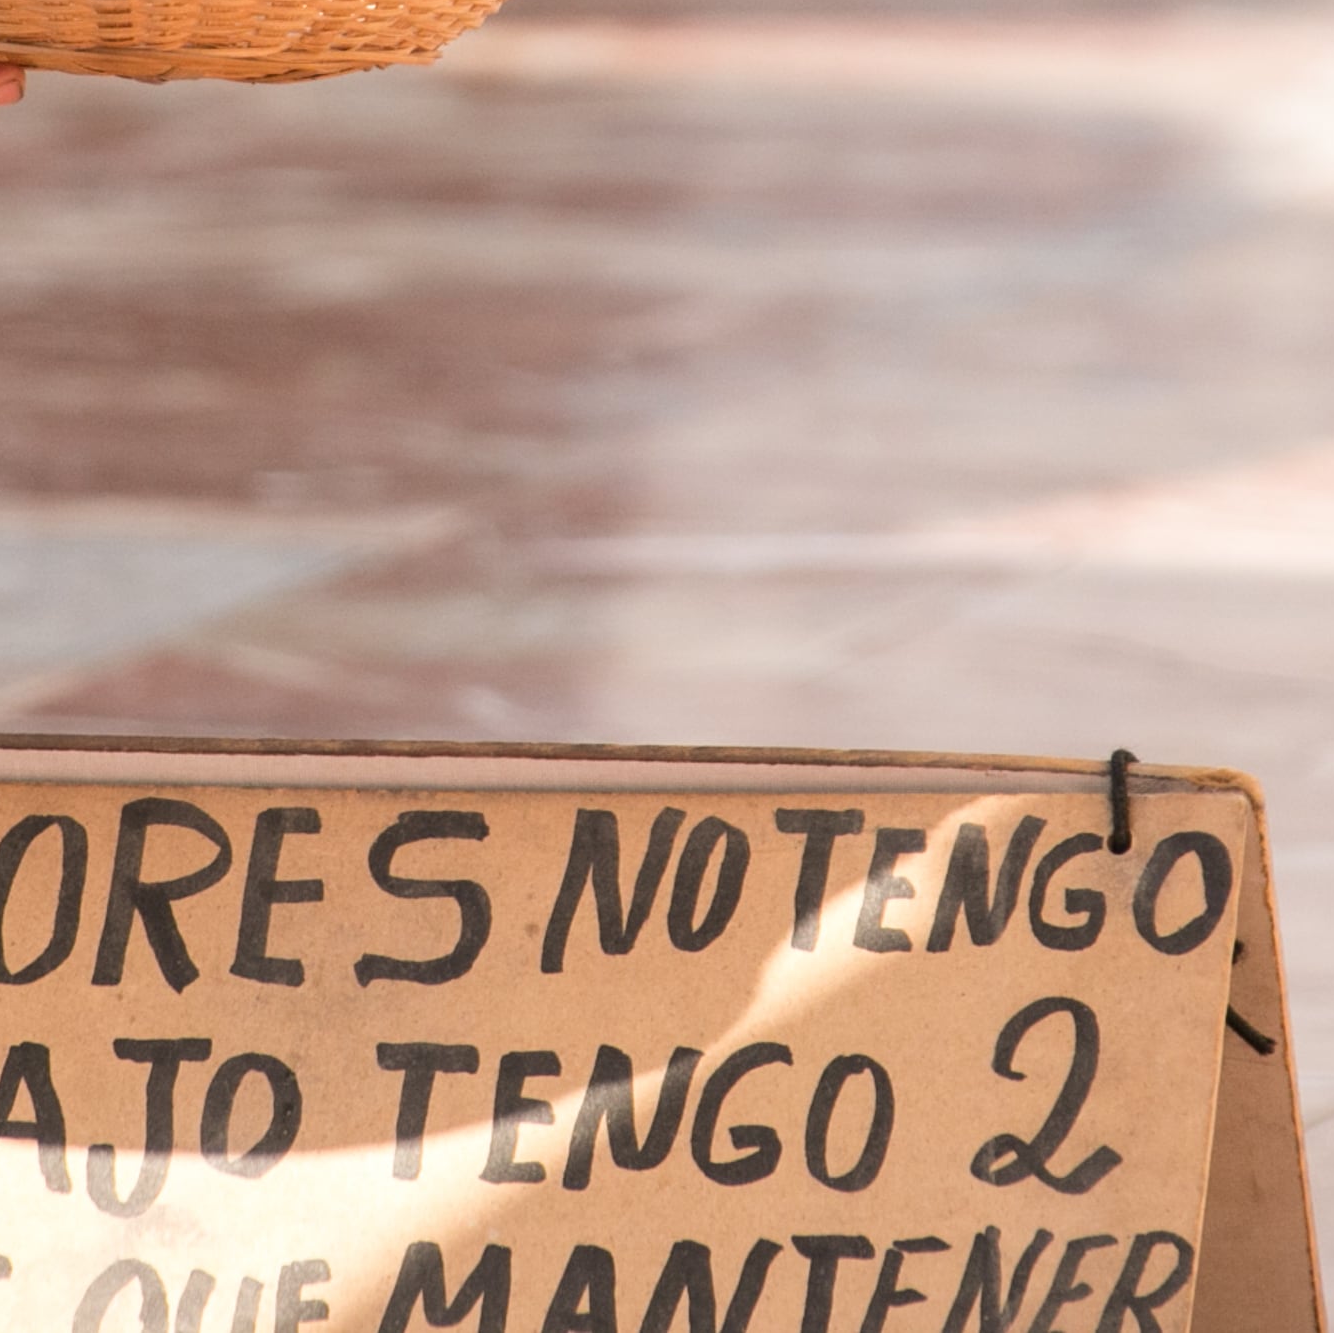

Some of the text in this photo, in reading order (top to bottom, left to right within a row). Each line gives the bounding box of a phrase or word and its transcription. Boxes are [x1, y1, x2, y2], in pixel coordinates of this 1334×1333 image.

[539, 805, 752, 975] NO
[774, 807, 1234, 956] TENGO
[375, 1041, 895, 1193] TENGO
[969, 996, 1123, 1195] 2
